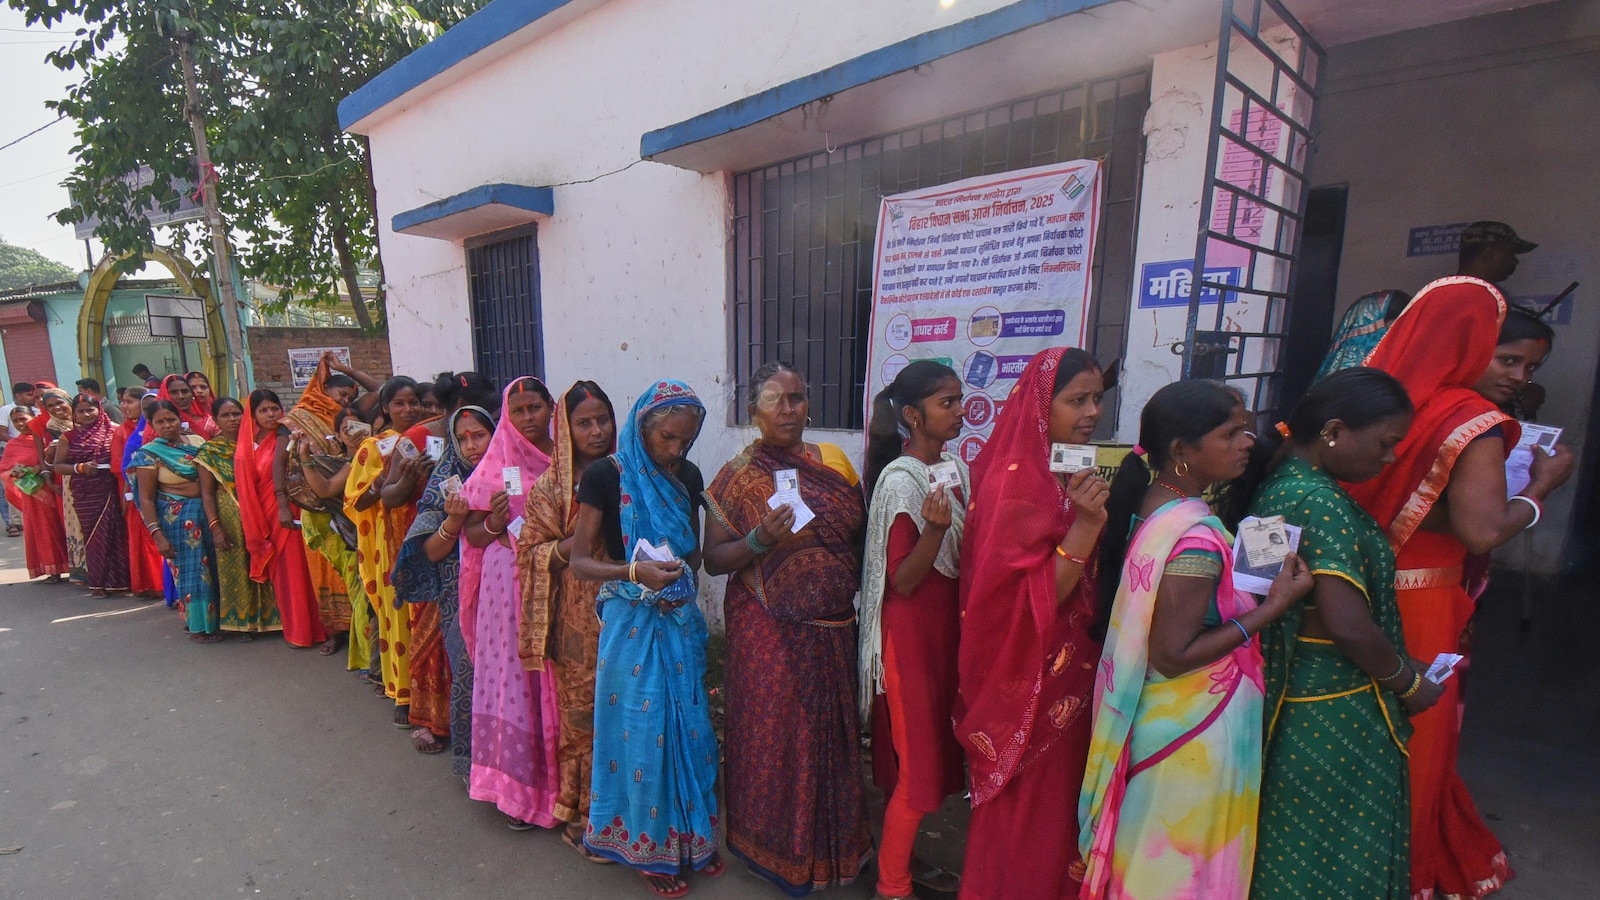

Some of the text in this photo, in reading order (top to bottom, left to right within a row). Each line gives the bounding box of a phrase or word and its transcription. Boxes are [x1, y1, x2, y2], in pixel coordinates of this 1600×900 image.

[983, 188, 1006, 200] आयोग
[1006, 186, 1022, 198] द्वारा
[909, 194, 1054, 231] बिहार विधान सभा आम निर्वाचन, 2025
[1046, 214, 1067, 224] मतदान
[1069, 212, 1085, 222] स्थल
[924, 250, 930, 258] से
[1043, 228, 1067, 241] निर्वाचक
[1069, 226, 1084, 239] फोटो
[1040, 245, 1065, 257] निर्वाचक
[1067, 243, 1082, 255] फोटो
[970, 272, 987, 282] पहचान
[988, 268, 1007, 280] स्थापित
[1008, 266, 1020, 278] करने
[1021, 265, 1027, 275] के
[1028, 264, 1040, 275] लिए
[1041, 261, 1081, 274] निम्नलिखित
[1008, 283, 1023, 292] करना
[1024, 280, 1038, 291] होगा
[913, 325, 933, 336] आधार
[934, 321, 949, 335] कार्ड
